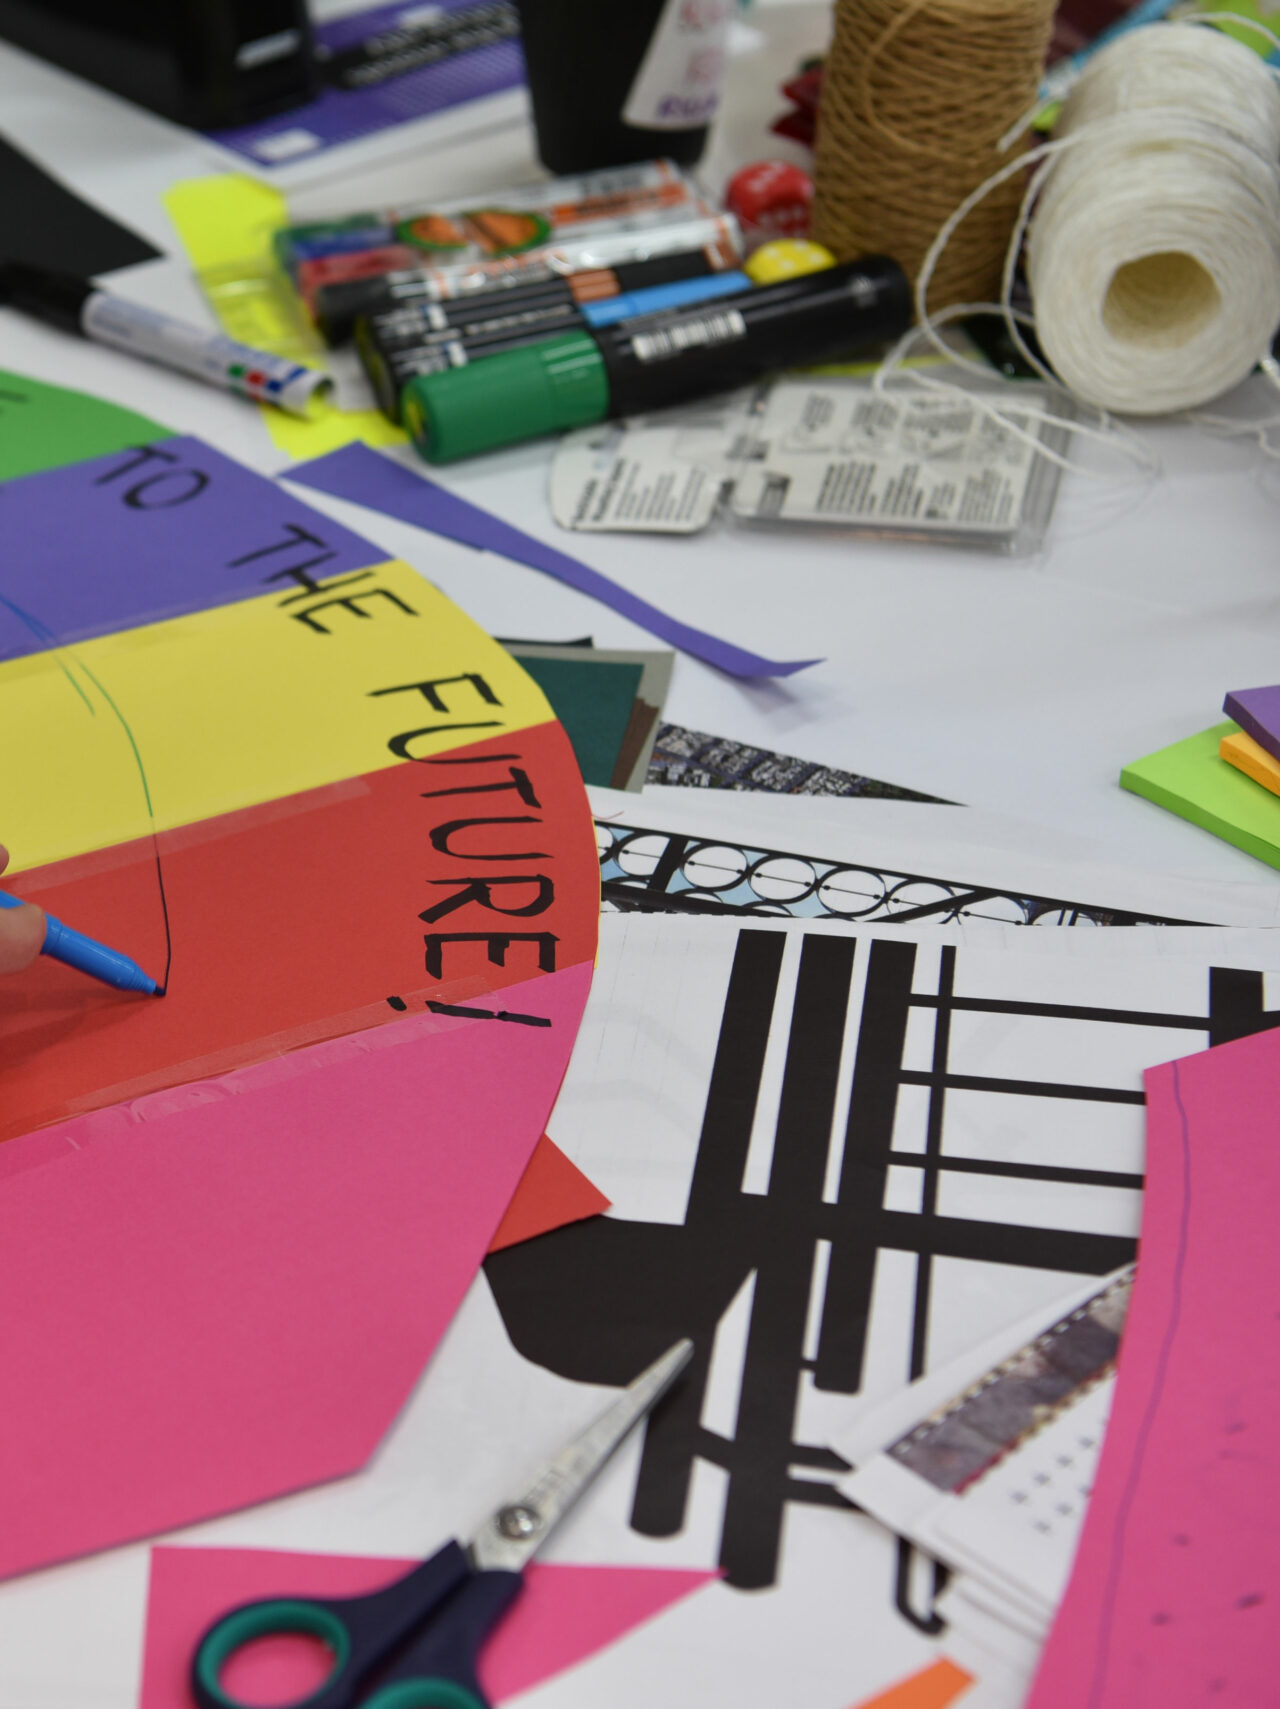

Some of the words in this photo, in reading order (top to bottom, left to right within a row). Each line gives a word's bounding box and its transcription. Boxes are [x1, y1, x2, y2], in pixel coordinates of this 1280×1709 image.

[94, 443, 211, 511] TO
[226, 523, 420, 635] THE
[364, 672, 561, 1028] FUTURE!
